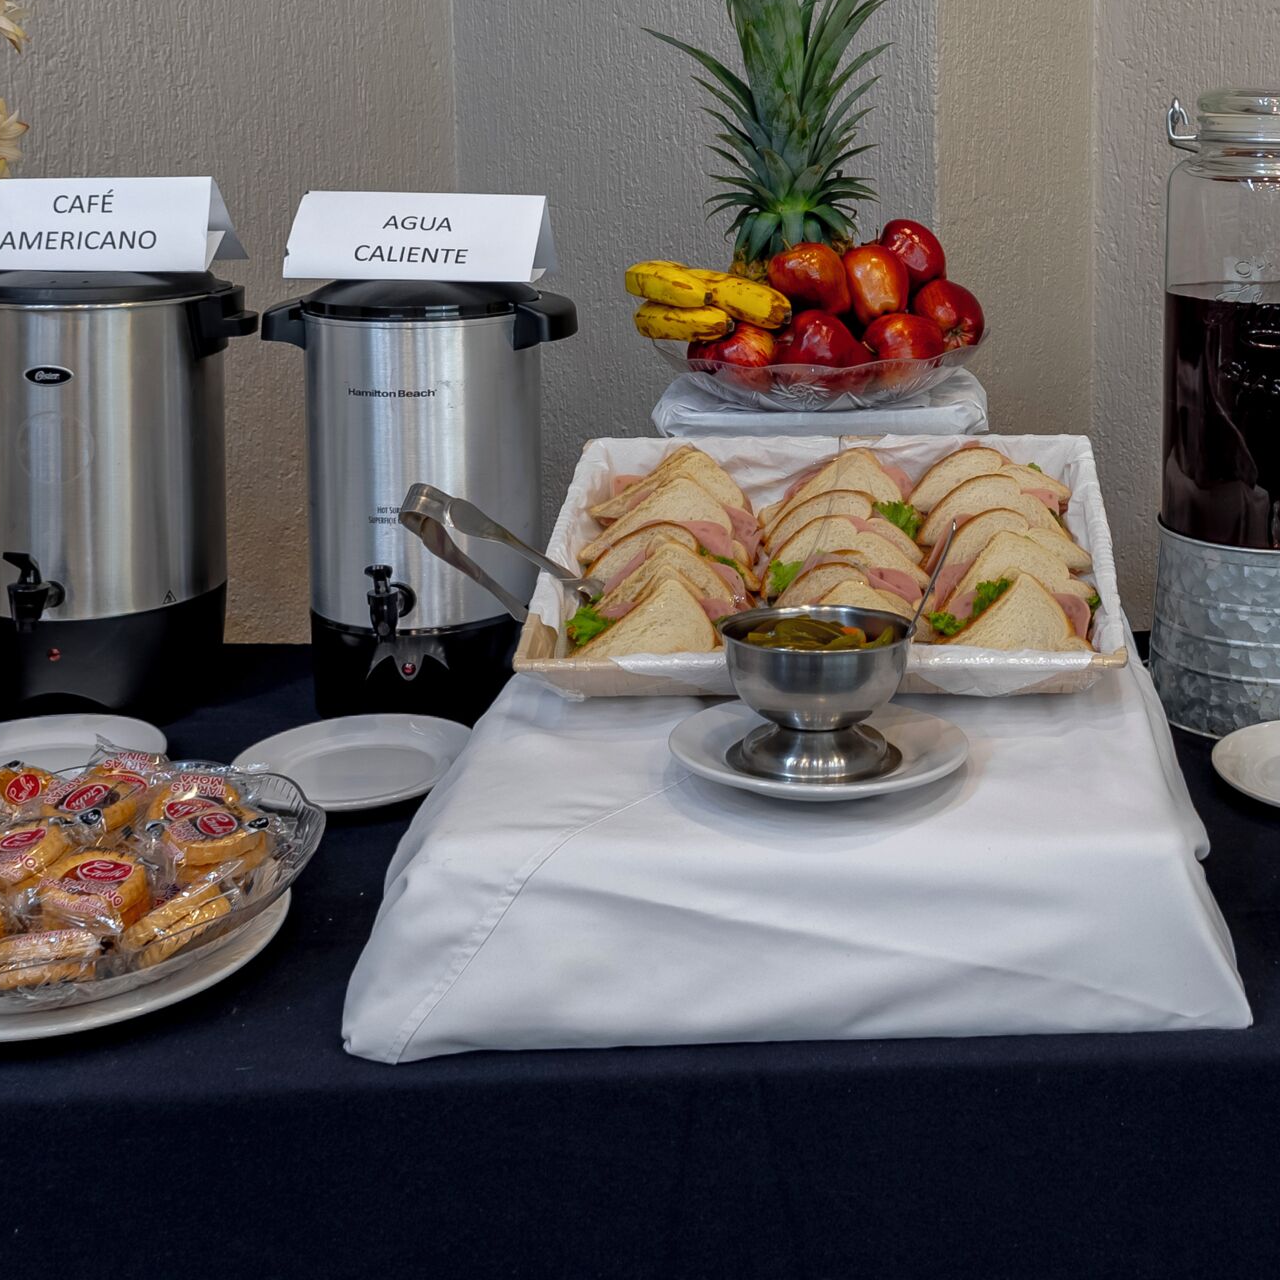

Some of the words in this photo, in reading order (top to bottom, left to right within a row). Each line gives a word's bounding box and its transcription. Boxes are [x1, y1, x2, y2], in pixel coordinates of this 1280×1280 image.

[52, 188, 114, 214] CAFÉ
[382, 215, 452, 232] AGUA
[354, 244, 469, 264] CALIENTE
[347, 387, 397, 398] Hamilton
[397, 389, 436, 398] Beach
[180, 774, 224, 787] MORA
[171, 781, 227, 798] TARAS
